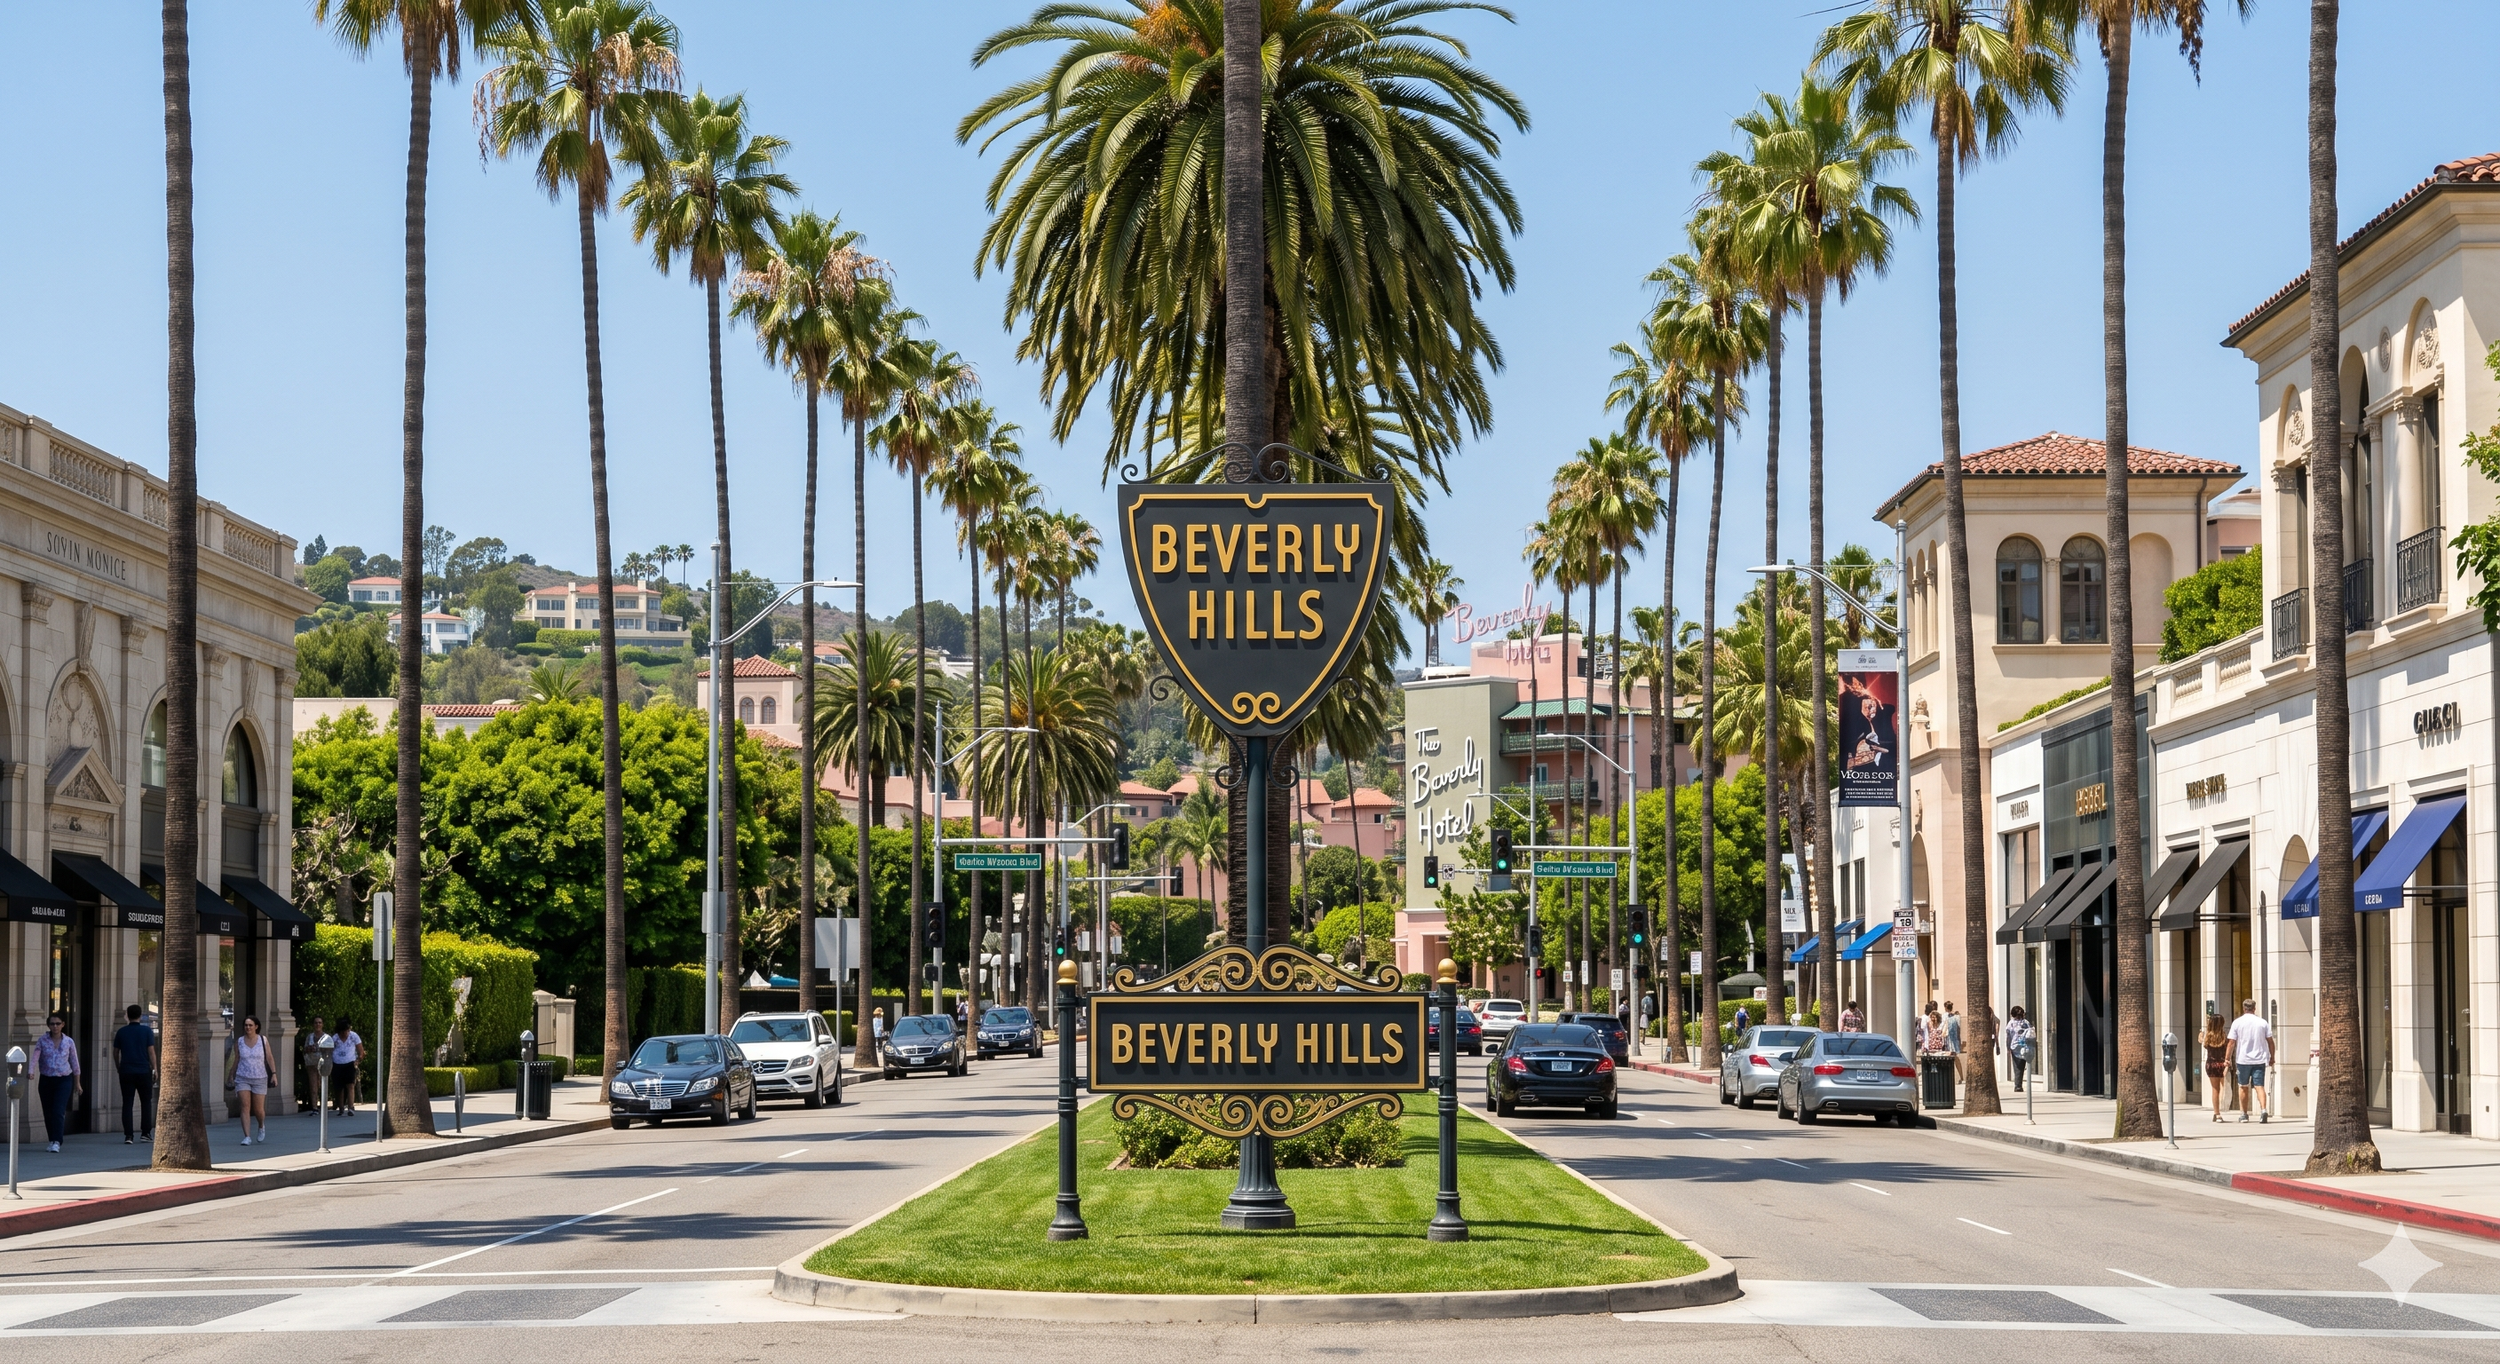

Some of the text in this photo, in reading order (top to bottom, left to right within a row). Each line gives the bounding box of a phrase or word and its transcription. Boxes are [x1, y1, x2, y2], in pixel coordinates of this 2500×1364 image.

[87, 547, 126, 581] MONICE
[1152, 524, 1360, 573] BEVERLY
[1188, 590, 1324, 640] HILLS
[1444, 582, 1553, 645] Beverly
[1419, 799, 1473, 853] Hotel
[1111, 1023, 1404, 1065] BEVERLY HILLS
